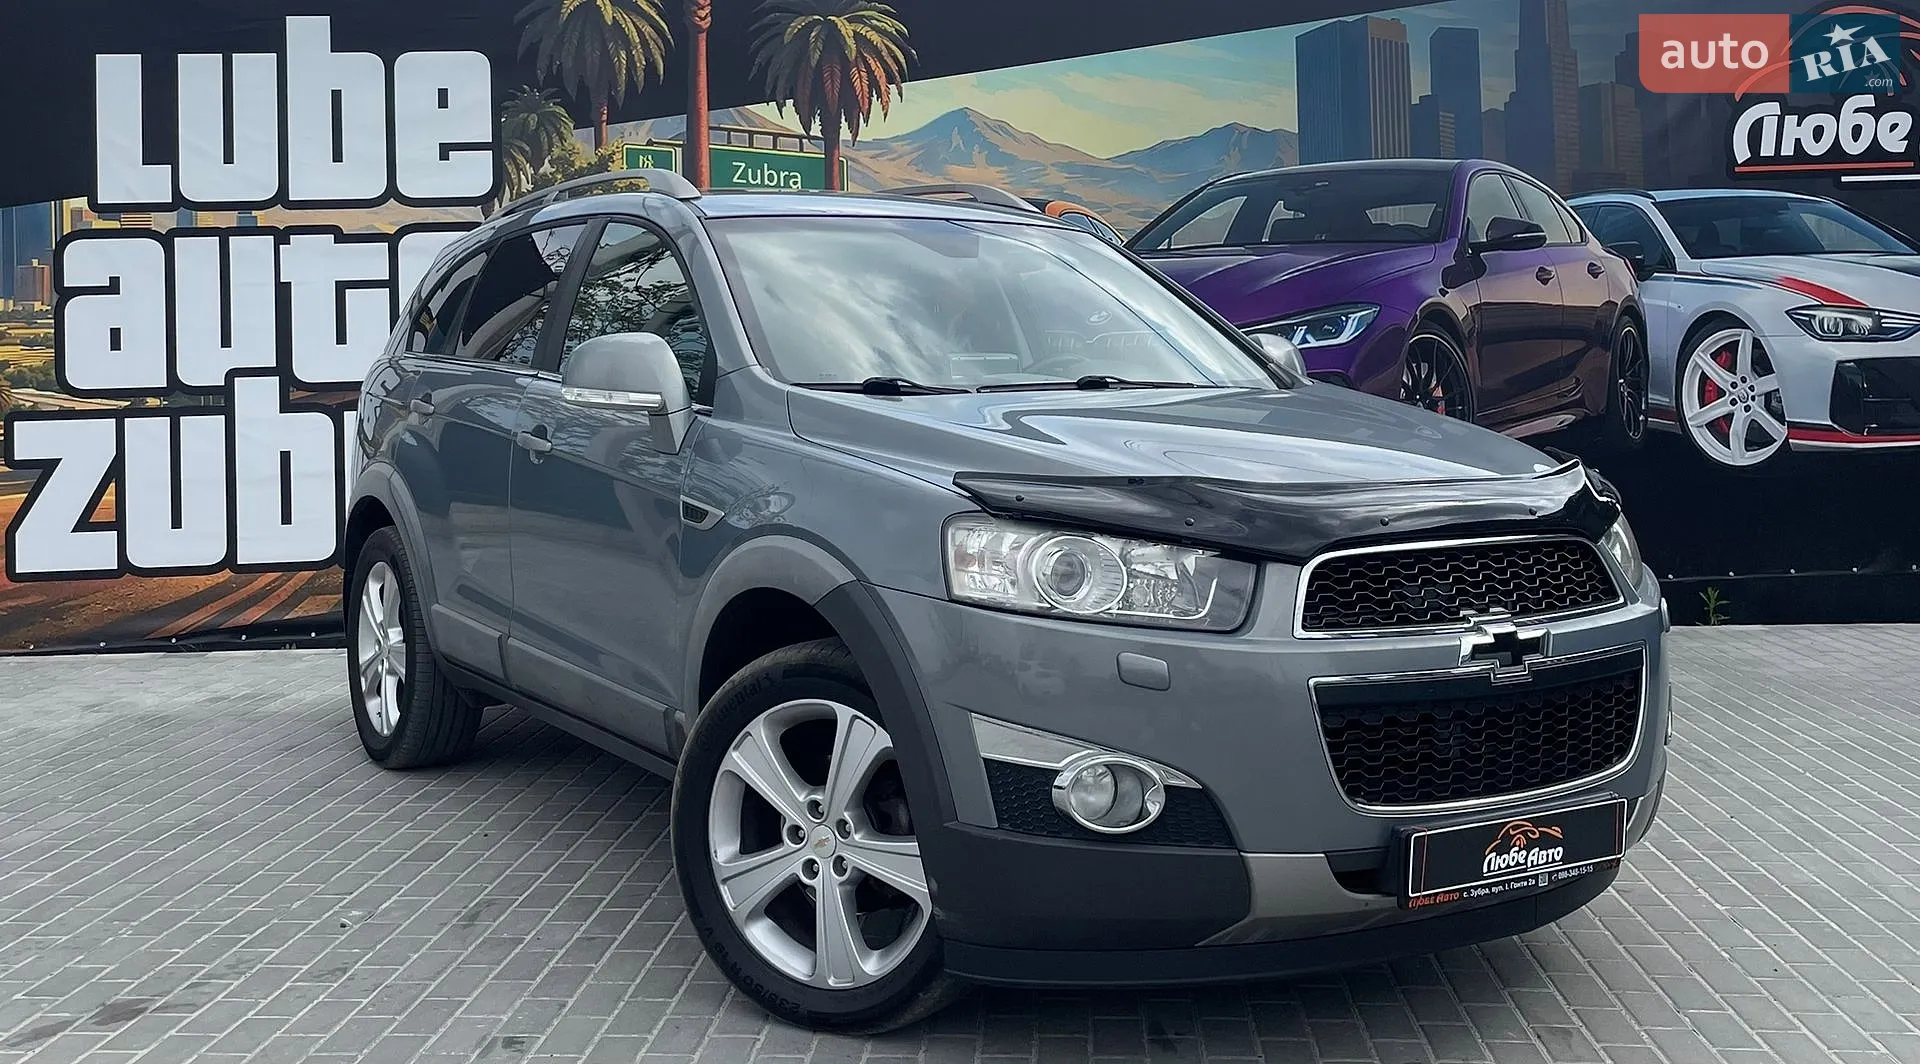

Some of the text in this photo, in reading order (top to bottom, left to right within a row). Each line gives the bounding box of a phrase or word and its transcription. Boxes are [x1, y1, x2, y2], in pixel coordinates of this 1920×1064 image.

[1733, 94, 1913, 164] Любе
[732, 161, 802, 190] Zubra
[62, 231, 470, 389] aut
[13, 376, 357, 574] zub
[1483, 846, 1564, 874] Любе Авто
